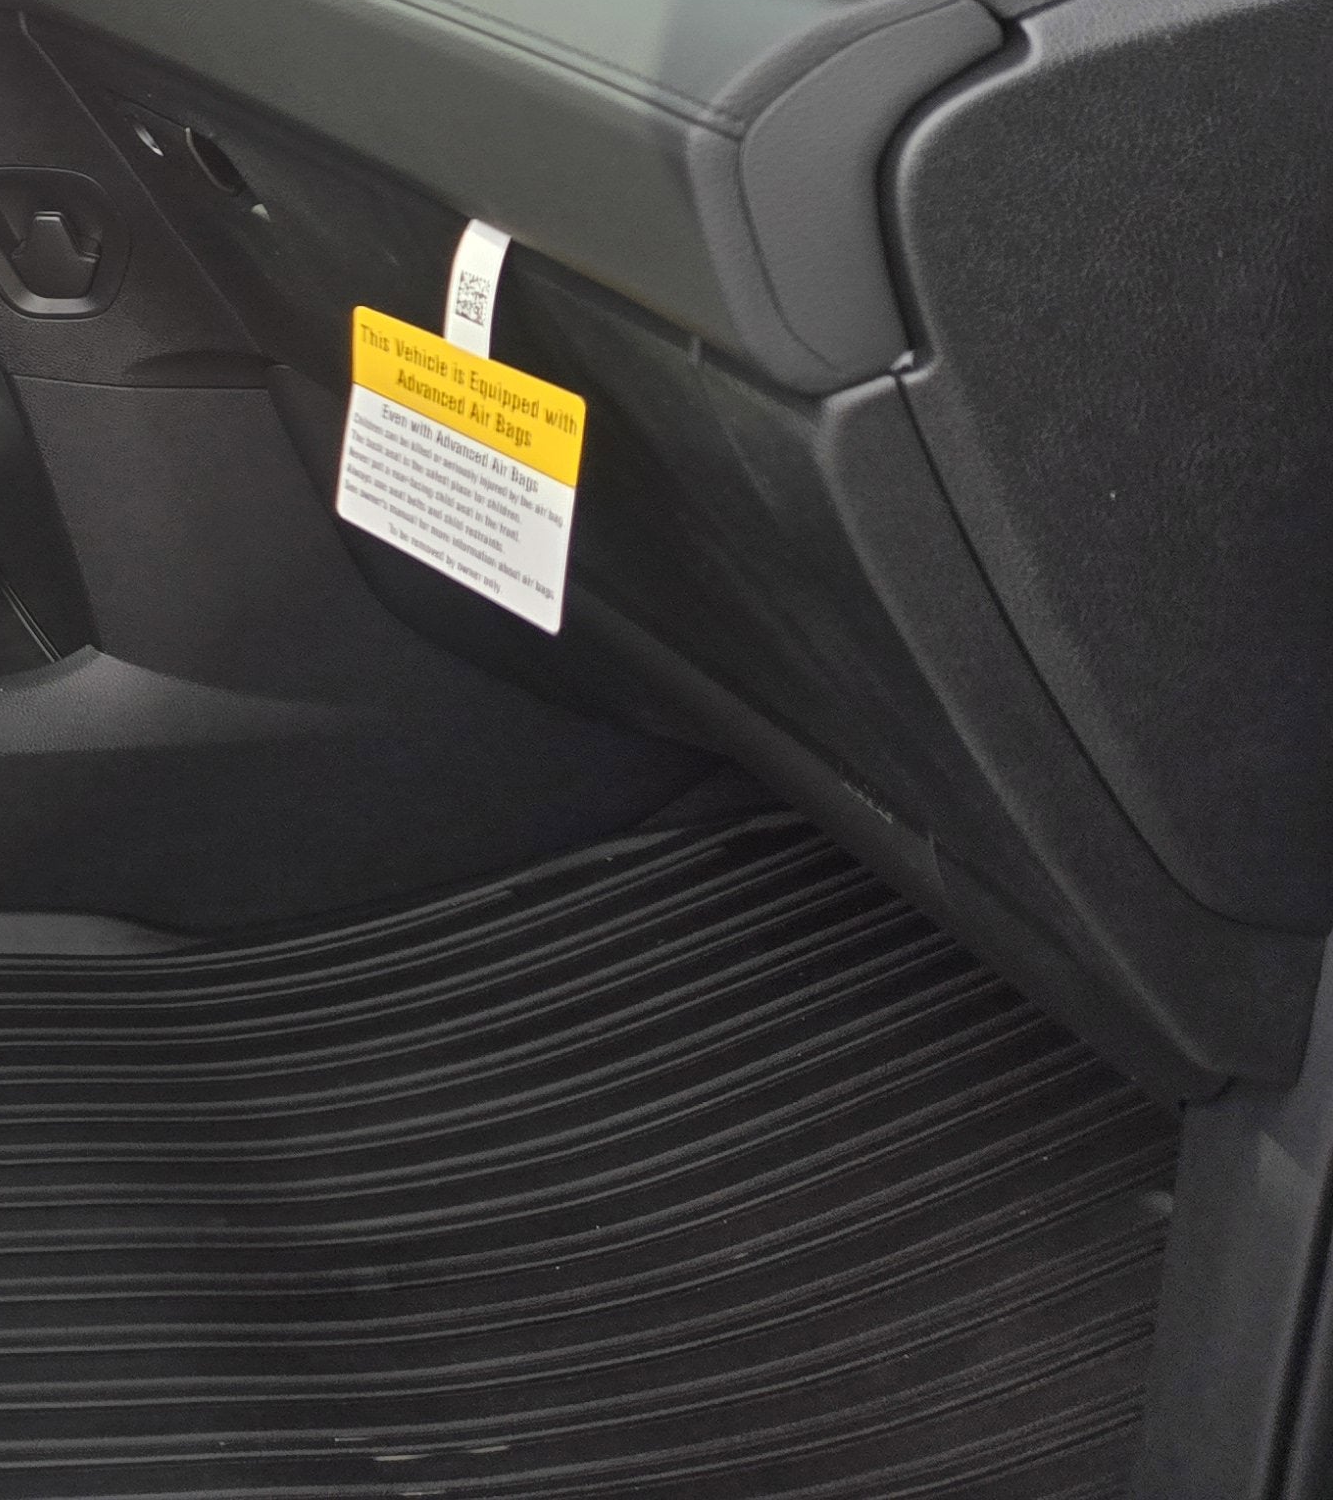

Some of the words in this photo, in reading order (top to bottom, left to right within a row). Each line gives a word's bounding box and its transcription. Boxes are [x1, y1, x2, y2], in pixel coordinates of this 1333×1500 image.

[359, 325, 390, 352] This
[394, 340, 448, 376] Vehicle
[452, 363, 465, 385] is
[468, 373, 540, 421] Equipped
[544, 405, 578, 435] with
[395, 370, 465, 414] Advanced
[469, 402, 491, 427] Air
[494, 415, 533, 451] Bags
[348, 447, 368, 464] Never
[371, 458, 384, 475] put
[384, 466, 390, 476] a
[391, 469, 434, 499] rear-facing
[435, 489, 454, 507] child
[456, 501, 473, 517] seat
[475, 510, 484, 523] in
[484, 515, 498, 530] the
[351, 429, 365, 444] The
[365, 438, 383, 454] back
[384, 447, 401, 463] seat
[403, 456, 410, 467] is
[411, 460, 424, 474] the
[425, 467, 449, 486] safest
[450, 480, 471, 498] place
[473, 491, 485, 504] for
[353, 413, 384, 436] Children
[384, 429, 398, 443] can
[399, 436, 410, 449] be
[410, 441, 432, 459] killed
[433, 453, 442, 465] or
[442, 459, 477, 484] seriously
[478, 476, 507, 499] injured
[508, 489, 518, 505] by
[519, 494, 534, 510] the
[534, 502, 547, 517] air
[381, 404, 408, 428] Even
[410, 418, 433, 440] with
[436, 432, 489, 468] Advanced
[491, 457, 508, 477] Air
[510, 468, 539, 495] Bags
[344, 479, 358, 494] See
[389, 504, 417, 525] manual
[418, 518, 429, 532] for
[430, 526, 449, 542] more
[451, 537, 497, 568] information
[497, 561, 520, 581] about
[521, 573, 534, 588] air
[346, 464, 371, 485] Always
[388, 485, 406, 501] seat
[406, 494, 426, 512] belts
[427, 505, 443, 520] and
[443, 513, 463, 531] child
[388, 522, 398, 536] To
[399, 529, 408, 542] be
[410, 536, 444, 561] removed
[445, 555, 455, 569] by
[457, 562, 480, 581] owner
